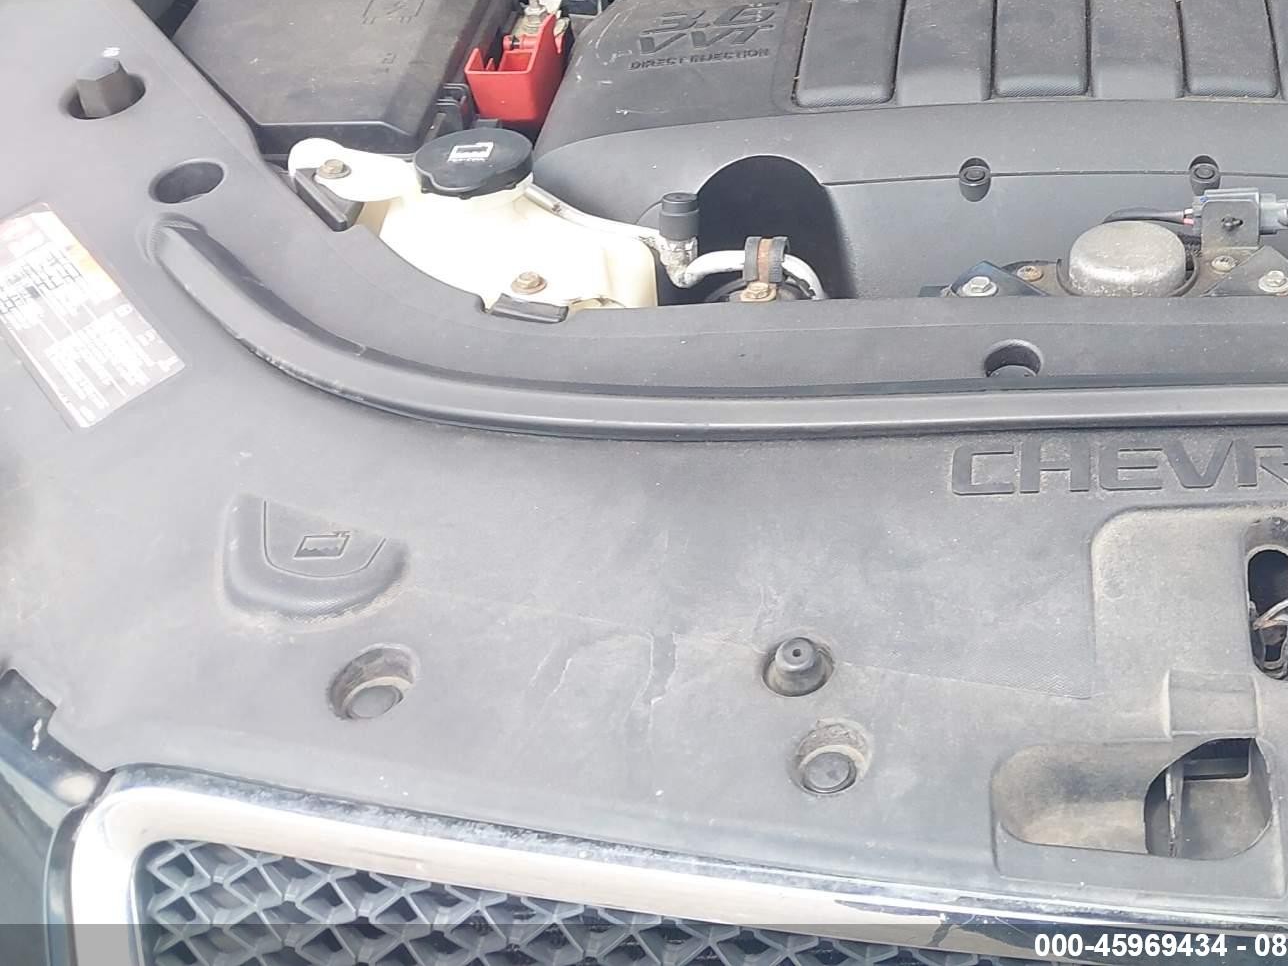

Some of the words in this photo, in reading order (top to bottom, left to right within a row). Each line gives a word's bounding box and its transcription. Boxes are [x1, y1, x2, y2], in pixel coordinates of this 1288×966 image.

[642, 2, 780, 34] 3.6
[639, 24, 775, 55] VVT
[629, 56, 686, 71] DIRECT
[689, 47, 770, 65] INJECTION
